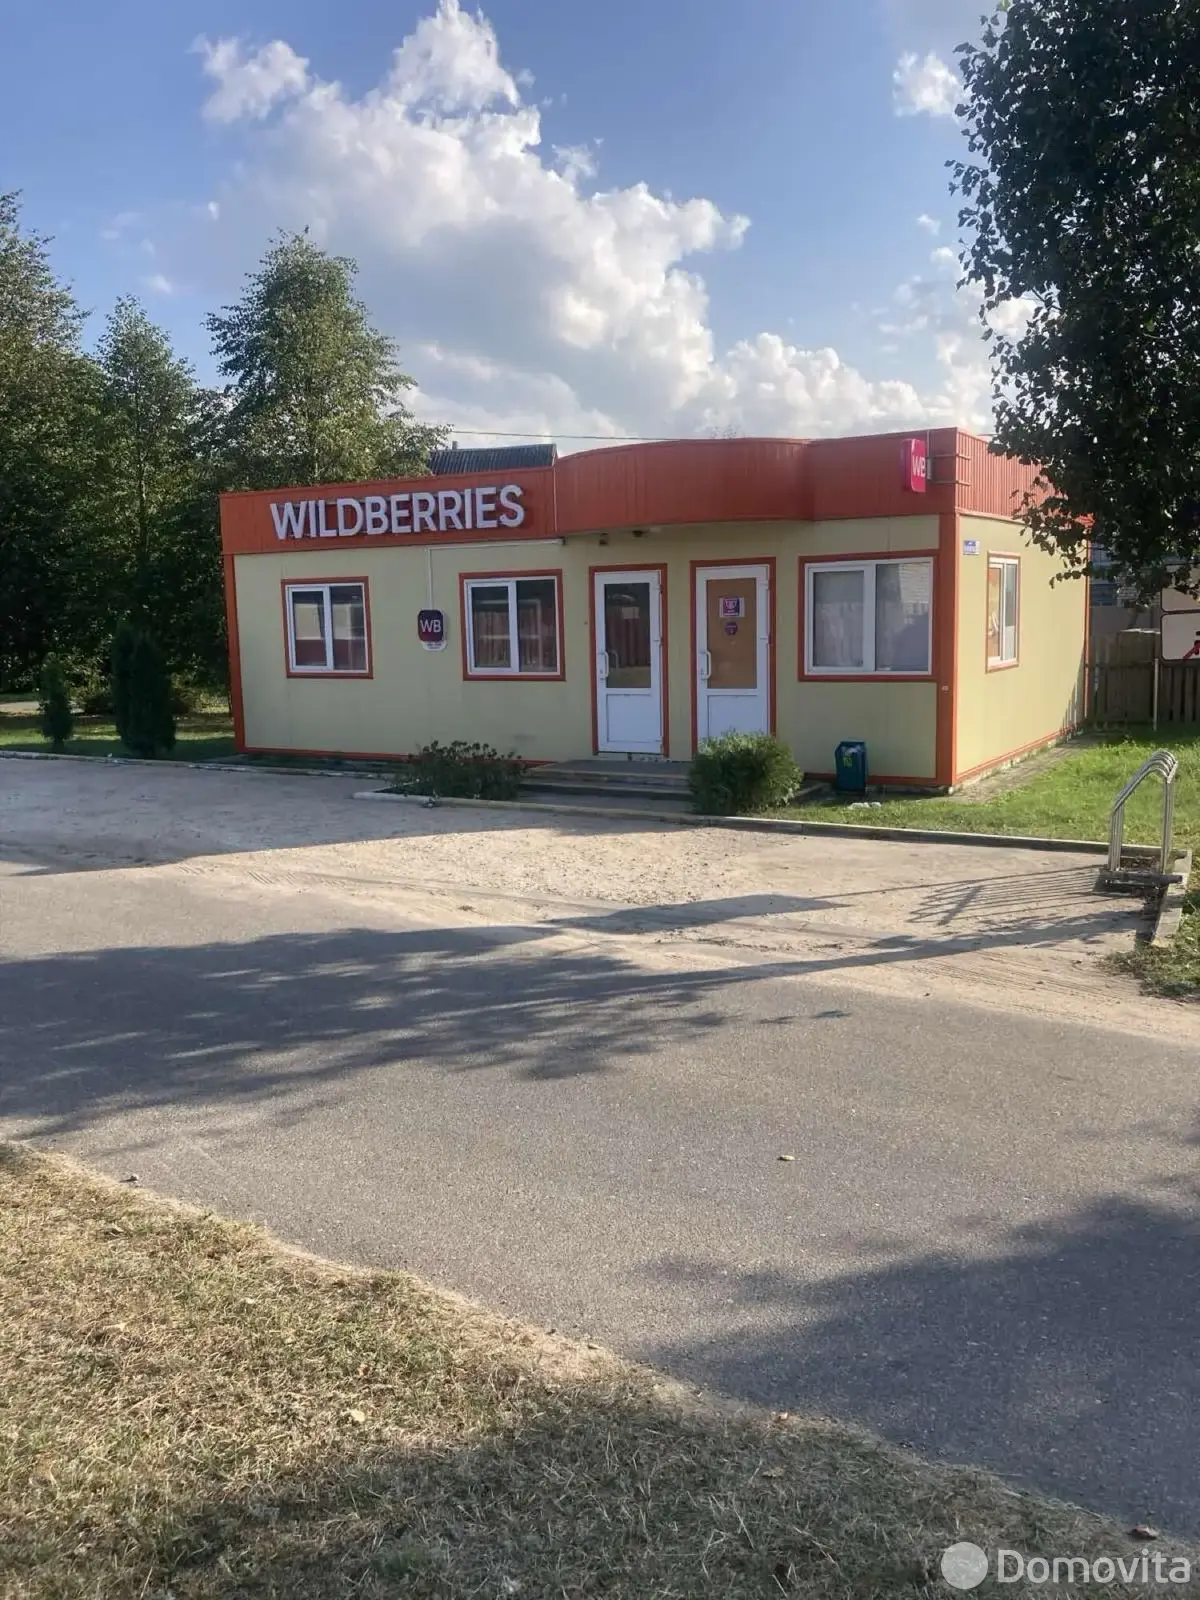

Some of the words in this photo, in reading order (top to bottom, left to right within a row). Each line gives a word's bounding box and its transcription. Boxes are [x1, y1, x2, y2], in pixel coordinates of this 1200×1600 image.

[912, 455, 926, 478] WB
[270, 484, 525, 541] WILDBERRIES
[420, 619, 441, 633] WB
